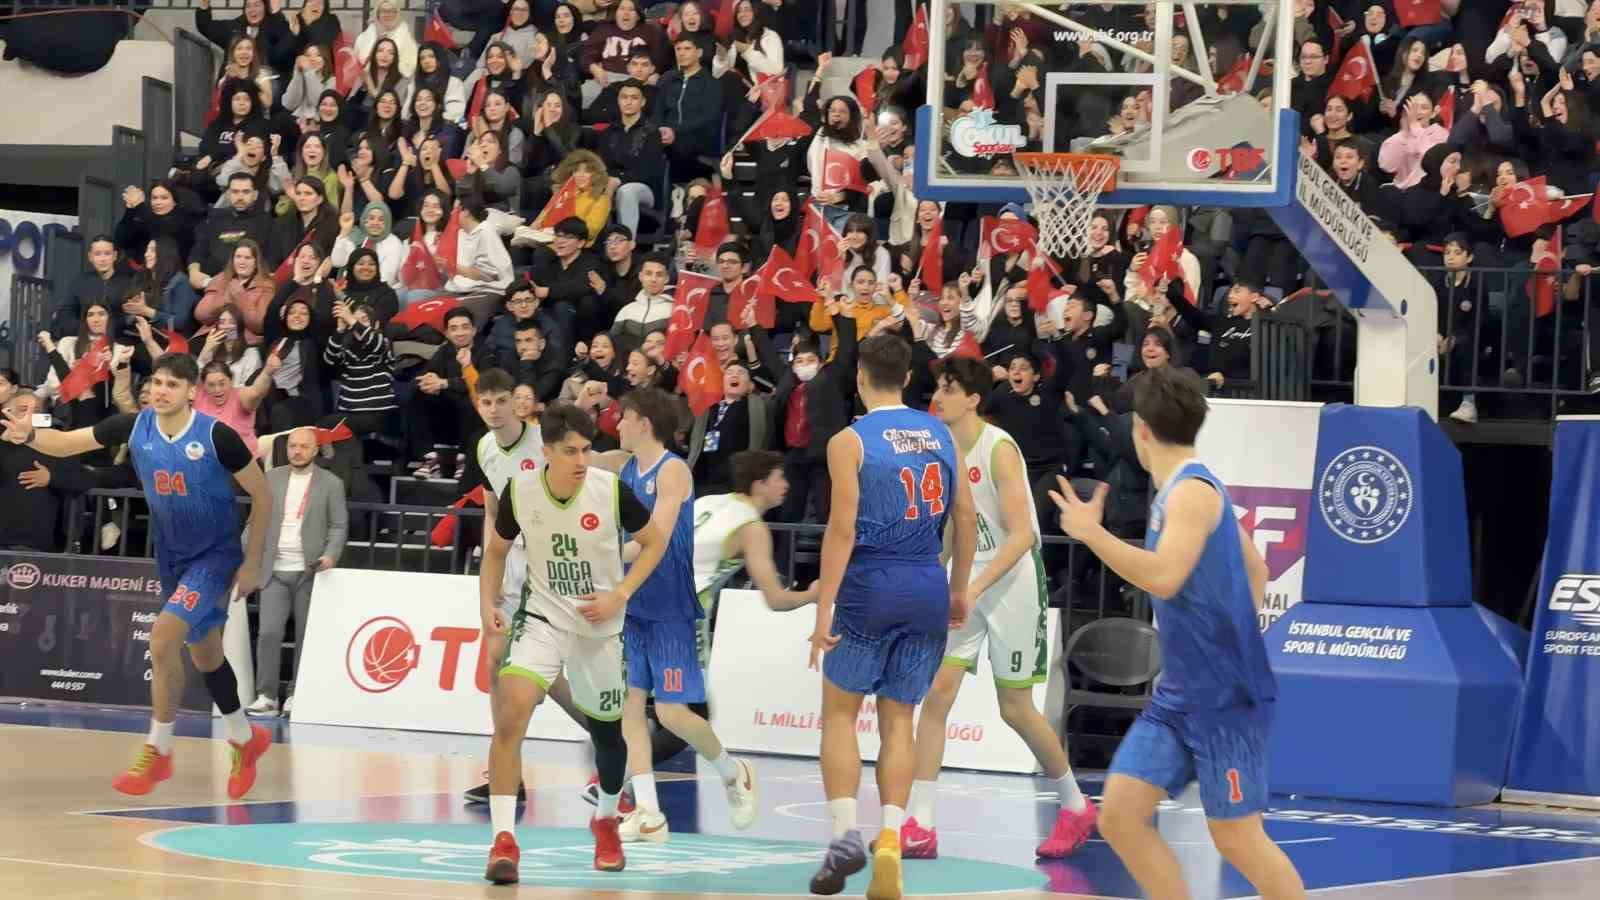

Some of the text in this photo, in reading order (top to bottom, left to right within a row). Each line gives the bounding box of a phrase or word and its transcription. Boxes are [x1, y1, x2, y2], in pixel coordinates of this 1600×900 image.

[1215, 147, 1265, 172] TBF
[153, 469, 187, 497] 24
[900, 462, 944, 520] 14
[551, 533, 578, 558] 24
[42, 573, 86, 588] KUKER
[89, 576, 143, 592] MADENİ
[168, 584, 201, 612] 24
[1288, 620, 1343, 637] İSTANBUL
[1344, 625, 1395, 643] GENÇLİK
[1395, 628, 1413, 641] VE
[1282, 640, 1407, 660] SPOR İL MÜDÜRLÜĞÜ
[1543, 644, 1579, 654] SPORT
[1011, 651, 1022, 673] 9
[663, 667, 683, 692] 11
[599, 689, 622, 711] 24
[1226, 768, 1243, 803] 1
